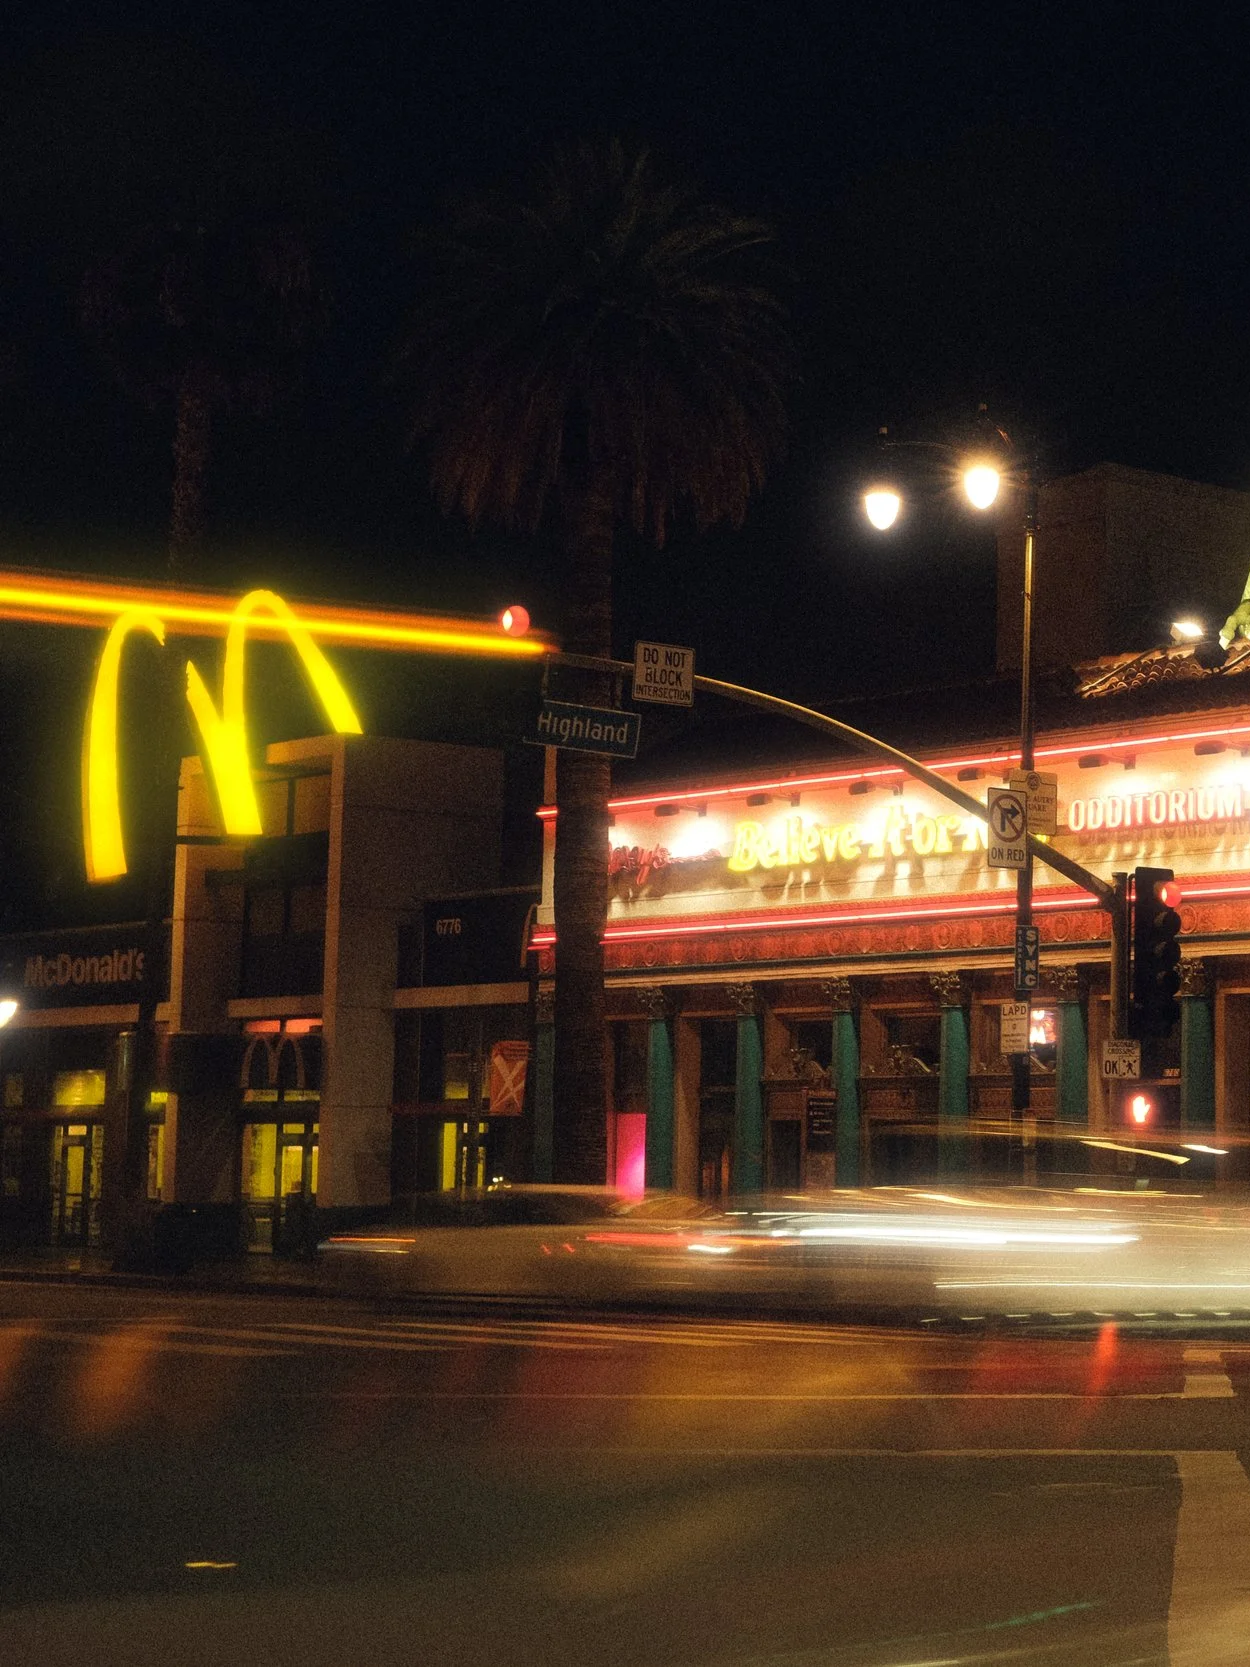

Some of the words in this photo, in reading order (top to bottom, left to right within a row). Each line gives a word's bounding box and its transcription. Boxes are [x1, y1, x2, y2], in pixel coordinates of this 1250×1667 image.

[643, 648, 658, 664] DO
[665, 650, 686, 669] NOT
[645, 668, 682, 688] BLOCK
[636, 683, 691, 701] INTERSECTION
[537, 711, 629, 745] Highland
[1068, 785, 1242, 833] ODDITORIUM
[728, 817, 861, 872] Believe
[911, 815, 960, 855] or
[991, 847, 1004, 860] ON
[1007, 849, 1025, 861] RED
[436, 918, 462, 936] 6776
[1025, 930, 1037, 986] SYNC
[1002, 1005, 1027, 1016] LAPD
[1105, 1060, 1118, 1074] OK
